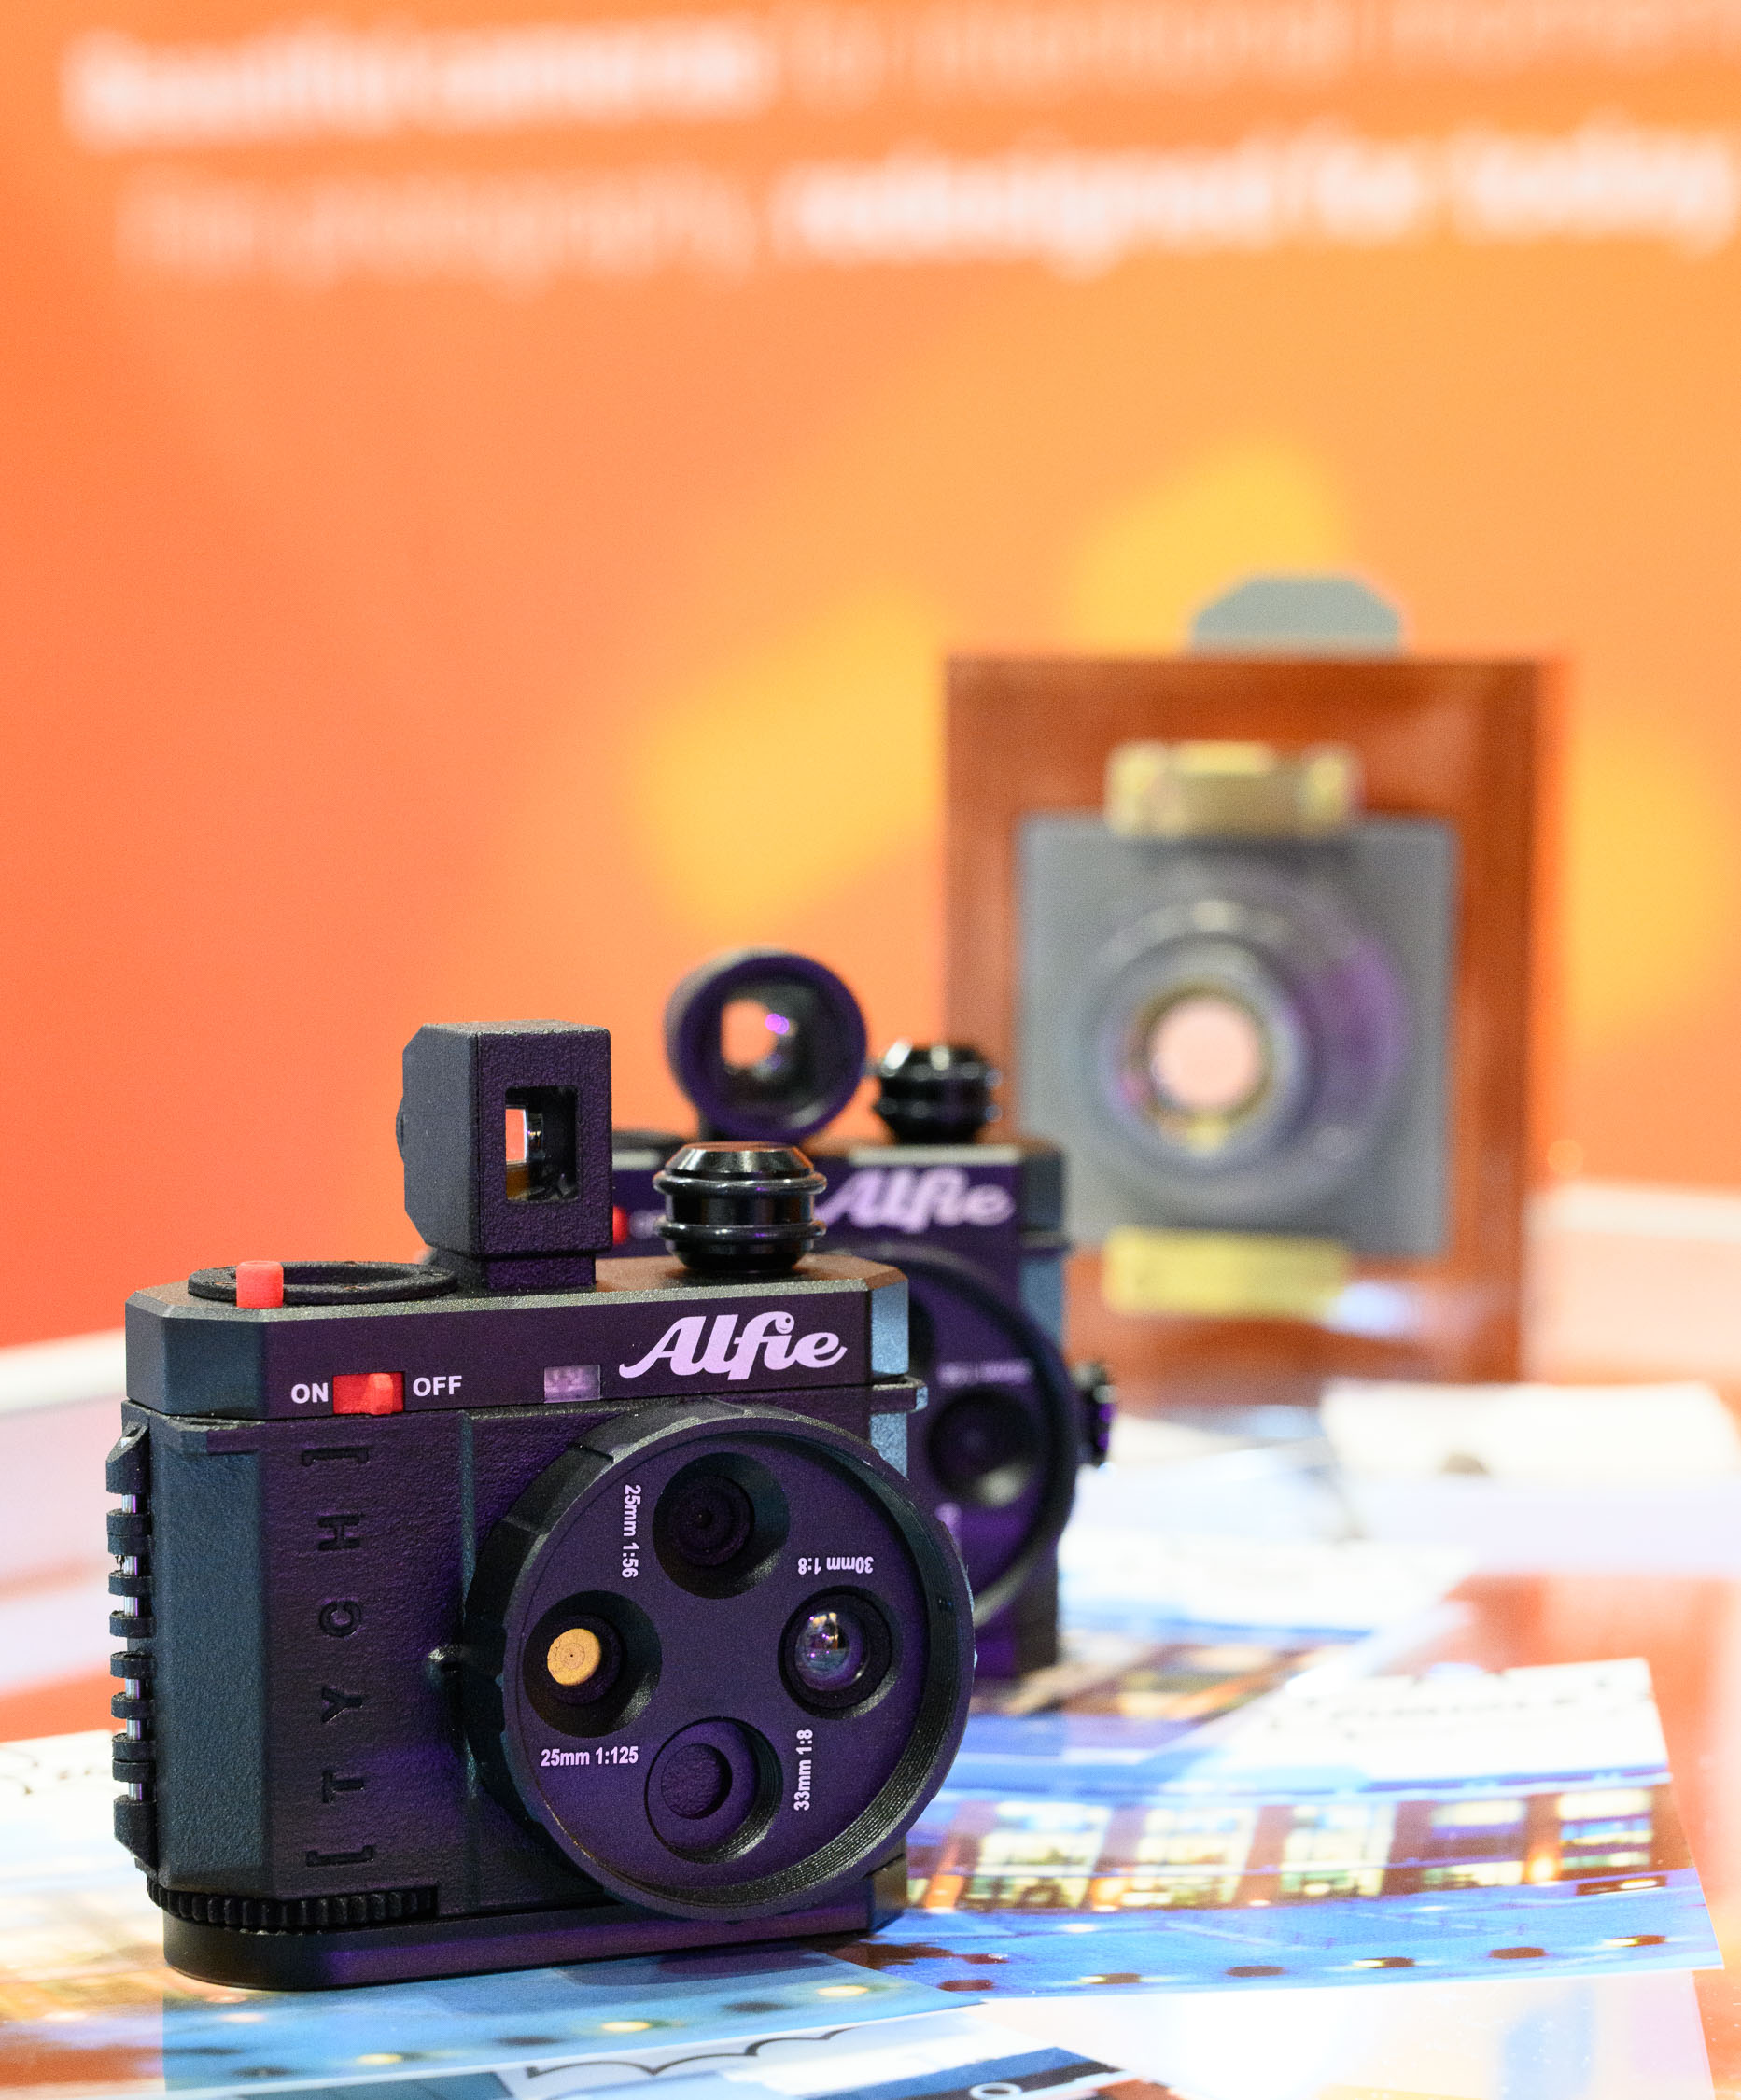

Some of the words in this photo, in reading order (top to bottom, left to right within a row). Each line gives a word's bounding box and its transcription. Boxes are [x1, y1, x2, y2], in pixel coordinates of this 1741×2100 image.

[618, 1310, 848, 1381] Alfie
[290, 1382, 329, 1404] ON
[413, 1375, 463, 1397] OFF
[623, 1484, 642, 1537] 25mm
[621, 1542, 639, 1578] 1:56
[797, 1557, 821, 1575] 1:8
[826, 1556, 875, 1575] 30mm
[795, 1729, 813, 1755] 1:8
[540, 1748, 590, 1767] 25mm
[595, 1745, 639, 1765] 1:125
[793, 1759, 812, 1811] 33mm
